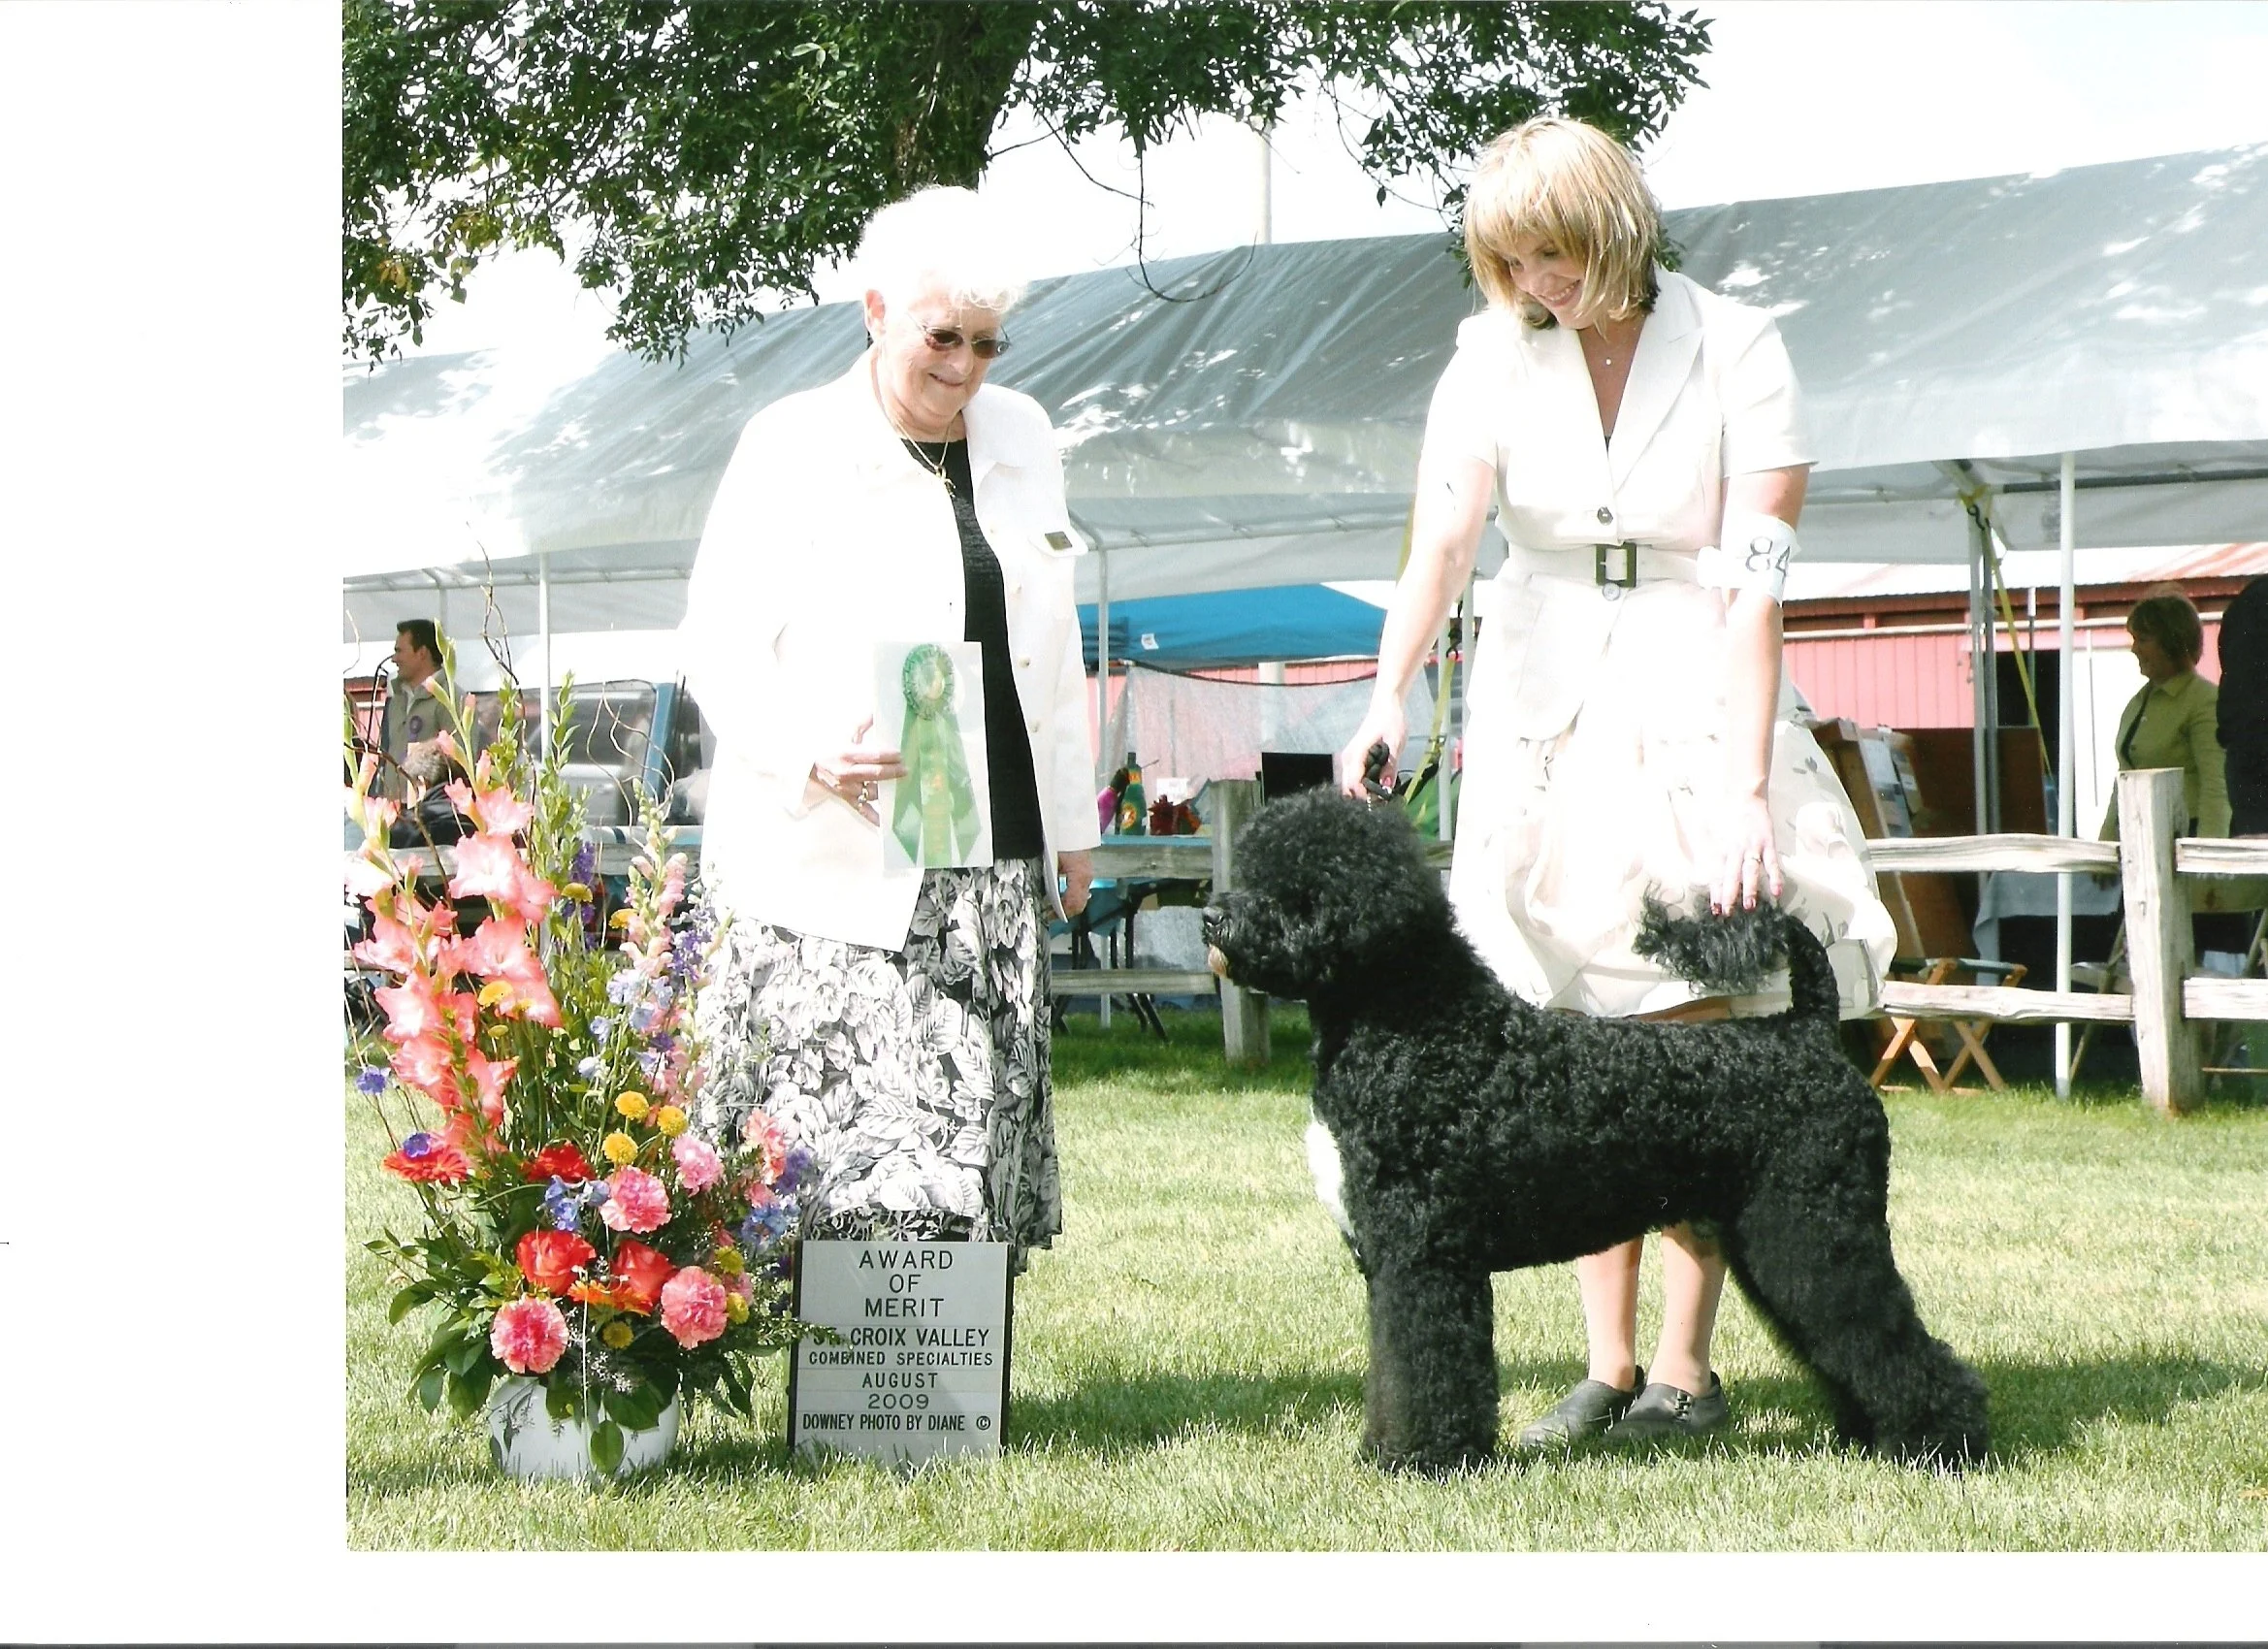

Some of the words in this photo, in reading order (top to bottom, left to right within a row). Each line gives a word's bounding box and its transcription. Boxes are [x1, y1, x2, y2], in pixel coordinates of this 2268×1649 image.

[859, 1250, 954, 1270] AWARD
[889, 1274, 922, 1293] OF
[865, 1298, 944, 1317] MERIT
[851, 1327, 906, 1346] CROIX
[917, 1329, 989, 1346] VALLEY
[809, 1351, 886, 1366] COMBINED
[896, 1352, 992, 1366] SPECIALTIES
[862, 1373, 938, 1388] AUGUST
[868, 1394, 929, 1409] 2009
[802, 1414, 854, 1430] DOWNEY
[860, 1414, 900, 1431] PHOTO
[906, 1415, 923, 1431] BY
[928, 1415, 965, 1431] DIANE
